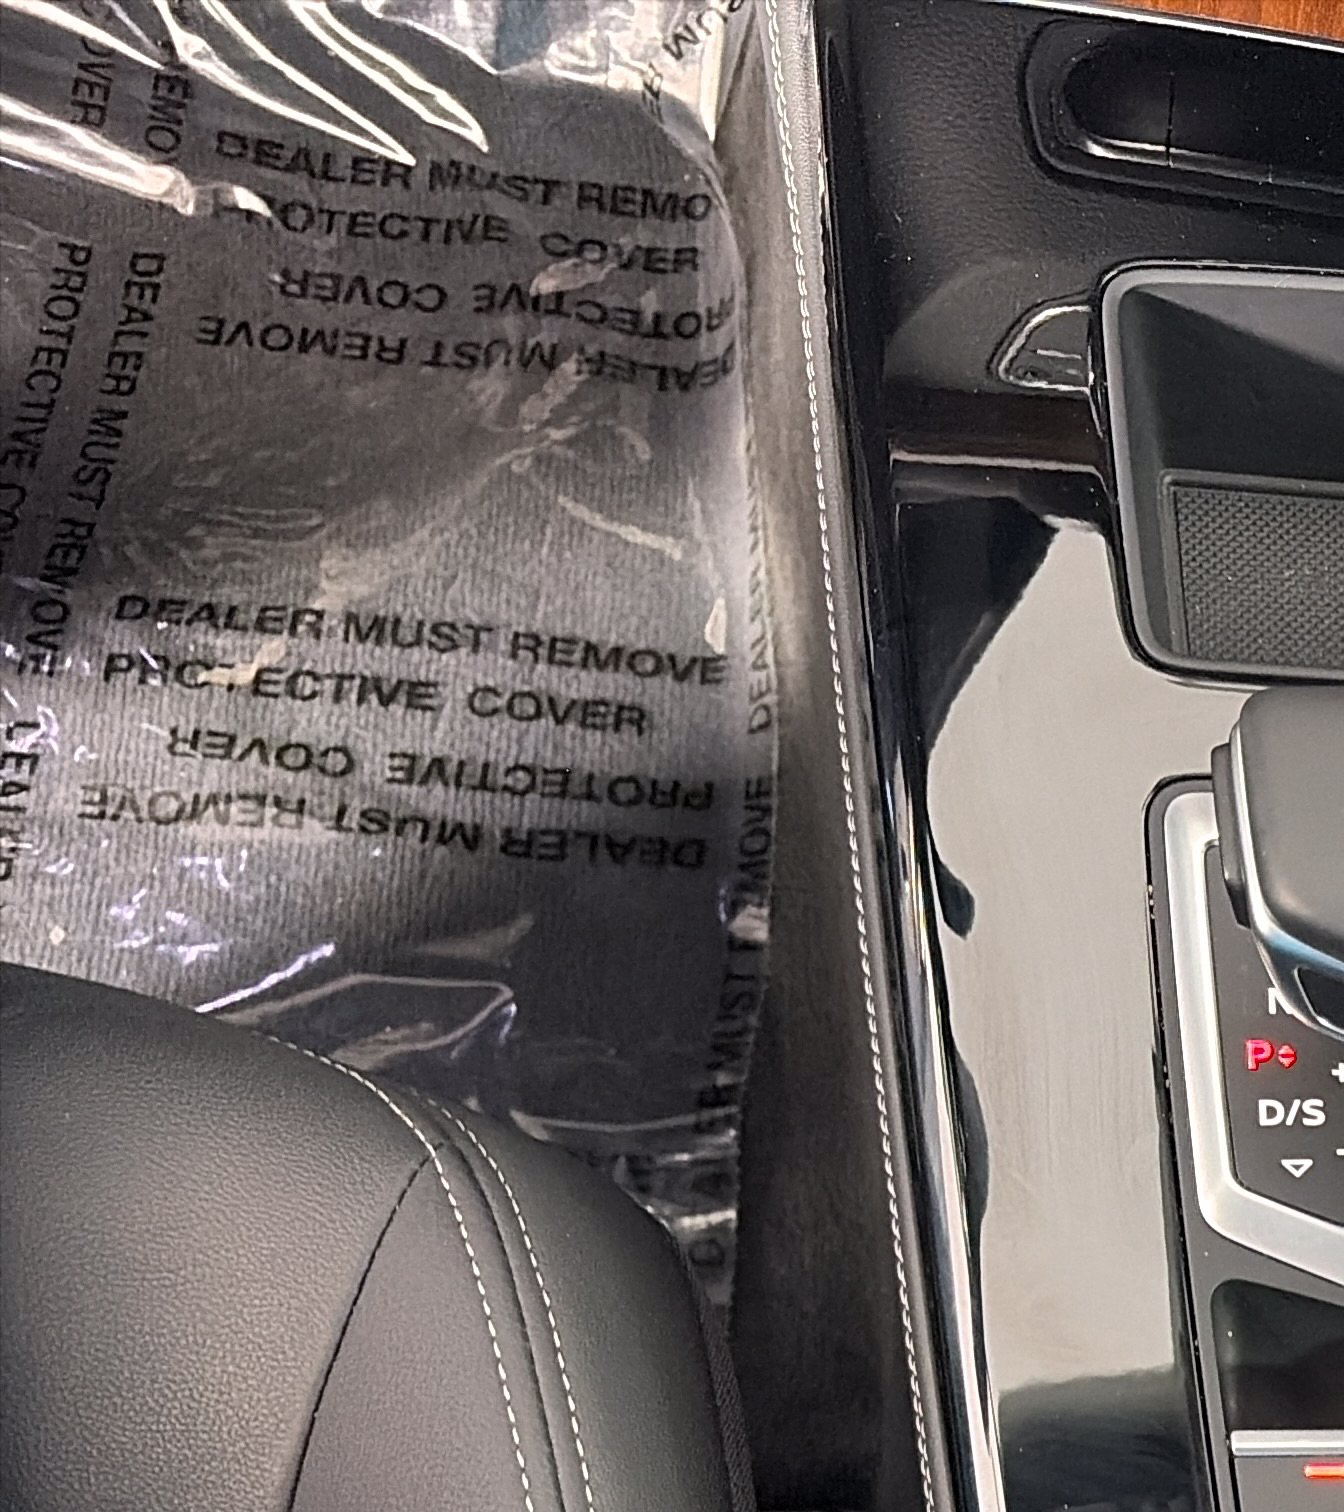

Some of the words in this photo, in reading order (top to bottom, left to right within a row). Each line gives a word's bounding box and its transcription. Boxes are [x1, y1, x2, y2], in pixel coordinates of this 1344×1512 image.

[216, 131, 413, 190] DEALER
[429, 159, 563, 207] MUST
[540, 231, 699, 274] COVER
[270, 266, 449, 314] COVER
[100, 252, 167, 397] DEALER
[195, 315, 410, 367] REMOVE
[1, 241, 93, 470] PROTECTIVE
[421, 338, 558, 372] MUST
[68, 405, 130, 511] MUST
[114, 595, 325, 641] DEALER
[343, 610, 493, 655] MUST
[511, 630, 728, 686] REMOVE
[468, 684, 647, 737] COVER
[168, 726, 353, 778] COVER
[77, 783, 306, 830] REMOVE
[386, 751, 715, 812] PROTECTIVE
[324, 802, 480, 851] MUST
[500, 826, 707, 869] DEALER
[1245, 1038, 1275, 1071] P
[1258, 1099, 1326, 1126] D/S
